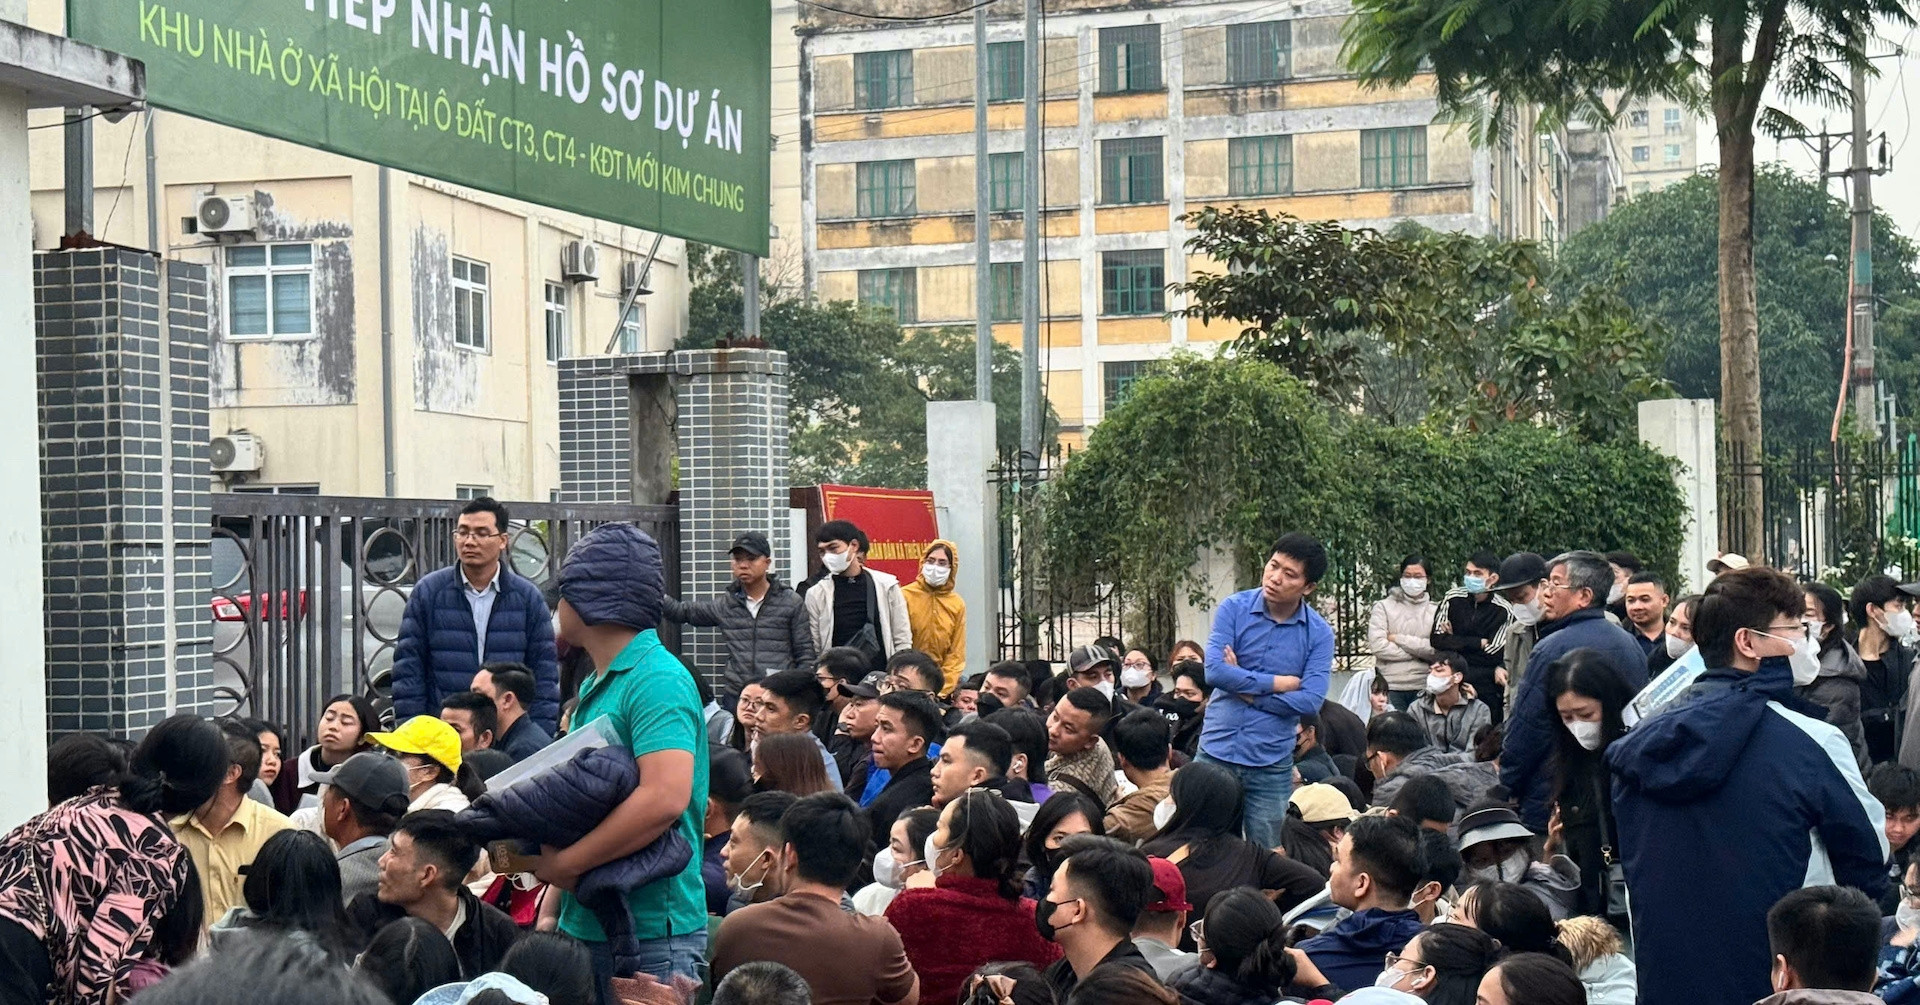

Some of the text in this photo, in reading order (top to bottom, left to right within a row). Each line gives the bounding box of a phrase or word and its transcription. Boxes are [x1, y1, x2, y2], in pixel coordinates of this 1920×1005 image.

[139, 0, 205, 58] KHU
[213, 23, 276, 81] NHÀ
[279, 37, 303, 87] Ở
[308, 52, 344, 101] XÃ
[348, 66, 391, 119] HỘI
[395, 82, 429, 131] TẠI
[433, 87, 452, 132] Ô
[455, 97, 497, 144] ĐẤT
[499, 116, 540, 162] CT3,
[542, 130, 577, 167] CT4
[589, 142, 625, 180] KĐT
[626, 151, 660, 190] MỚI
[662, 165, 691, 198] KIM
[693, 172, 745, 212] CHUNG
[411, 0, 526, 86] NHẬN
[540, 29, 591, 104] HỒ
[600, 61, 645, 121] SƠ
[654, 79, 700, 150] DỰ
[704, 88, 743, 154] ÁN
